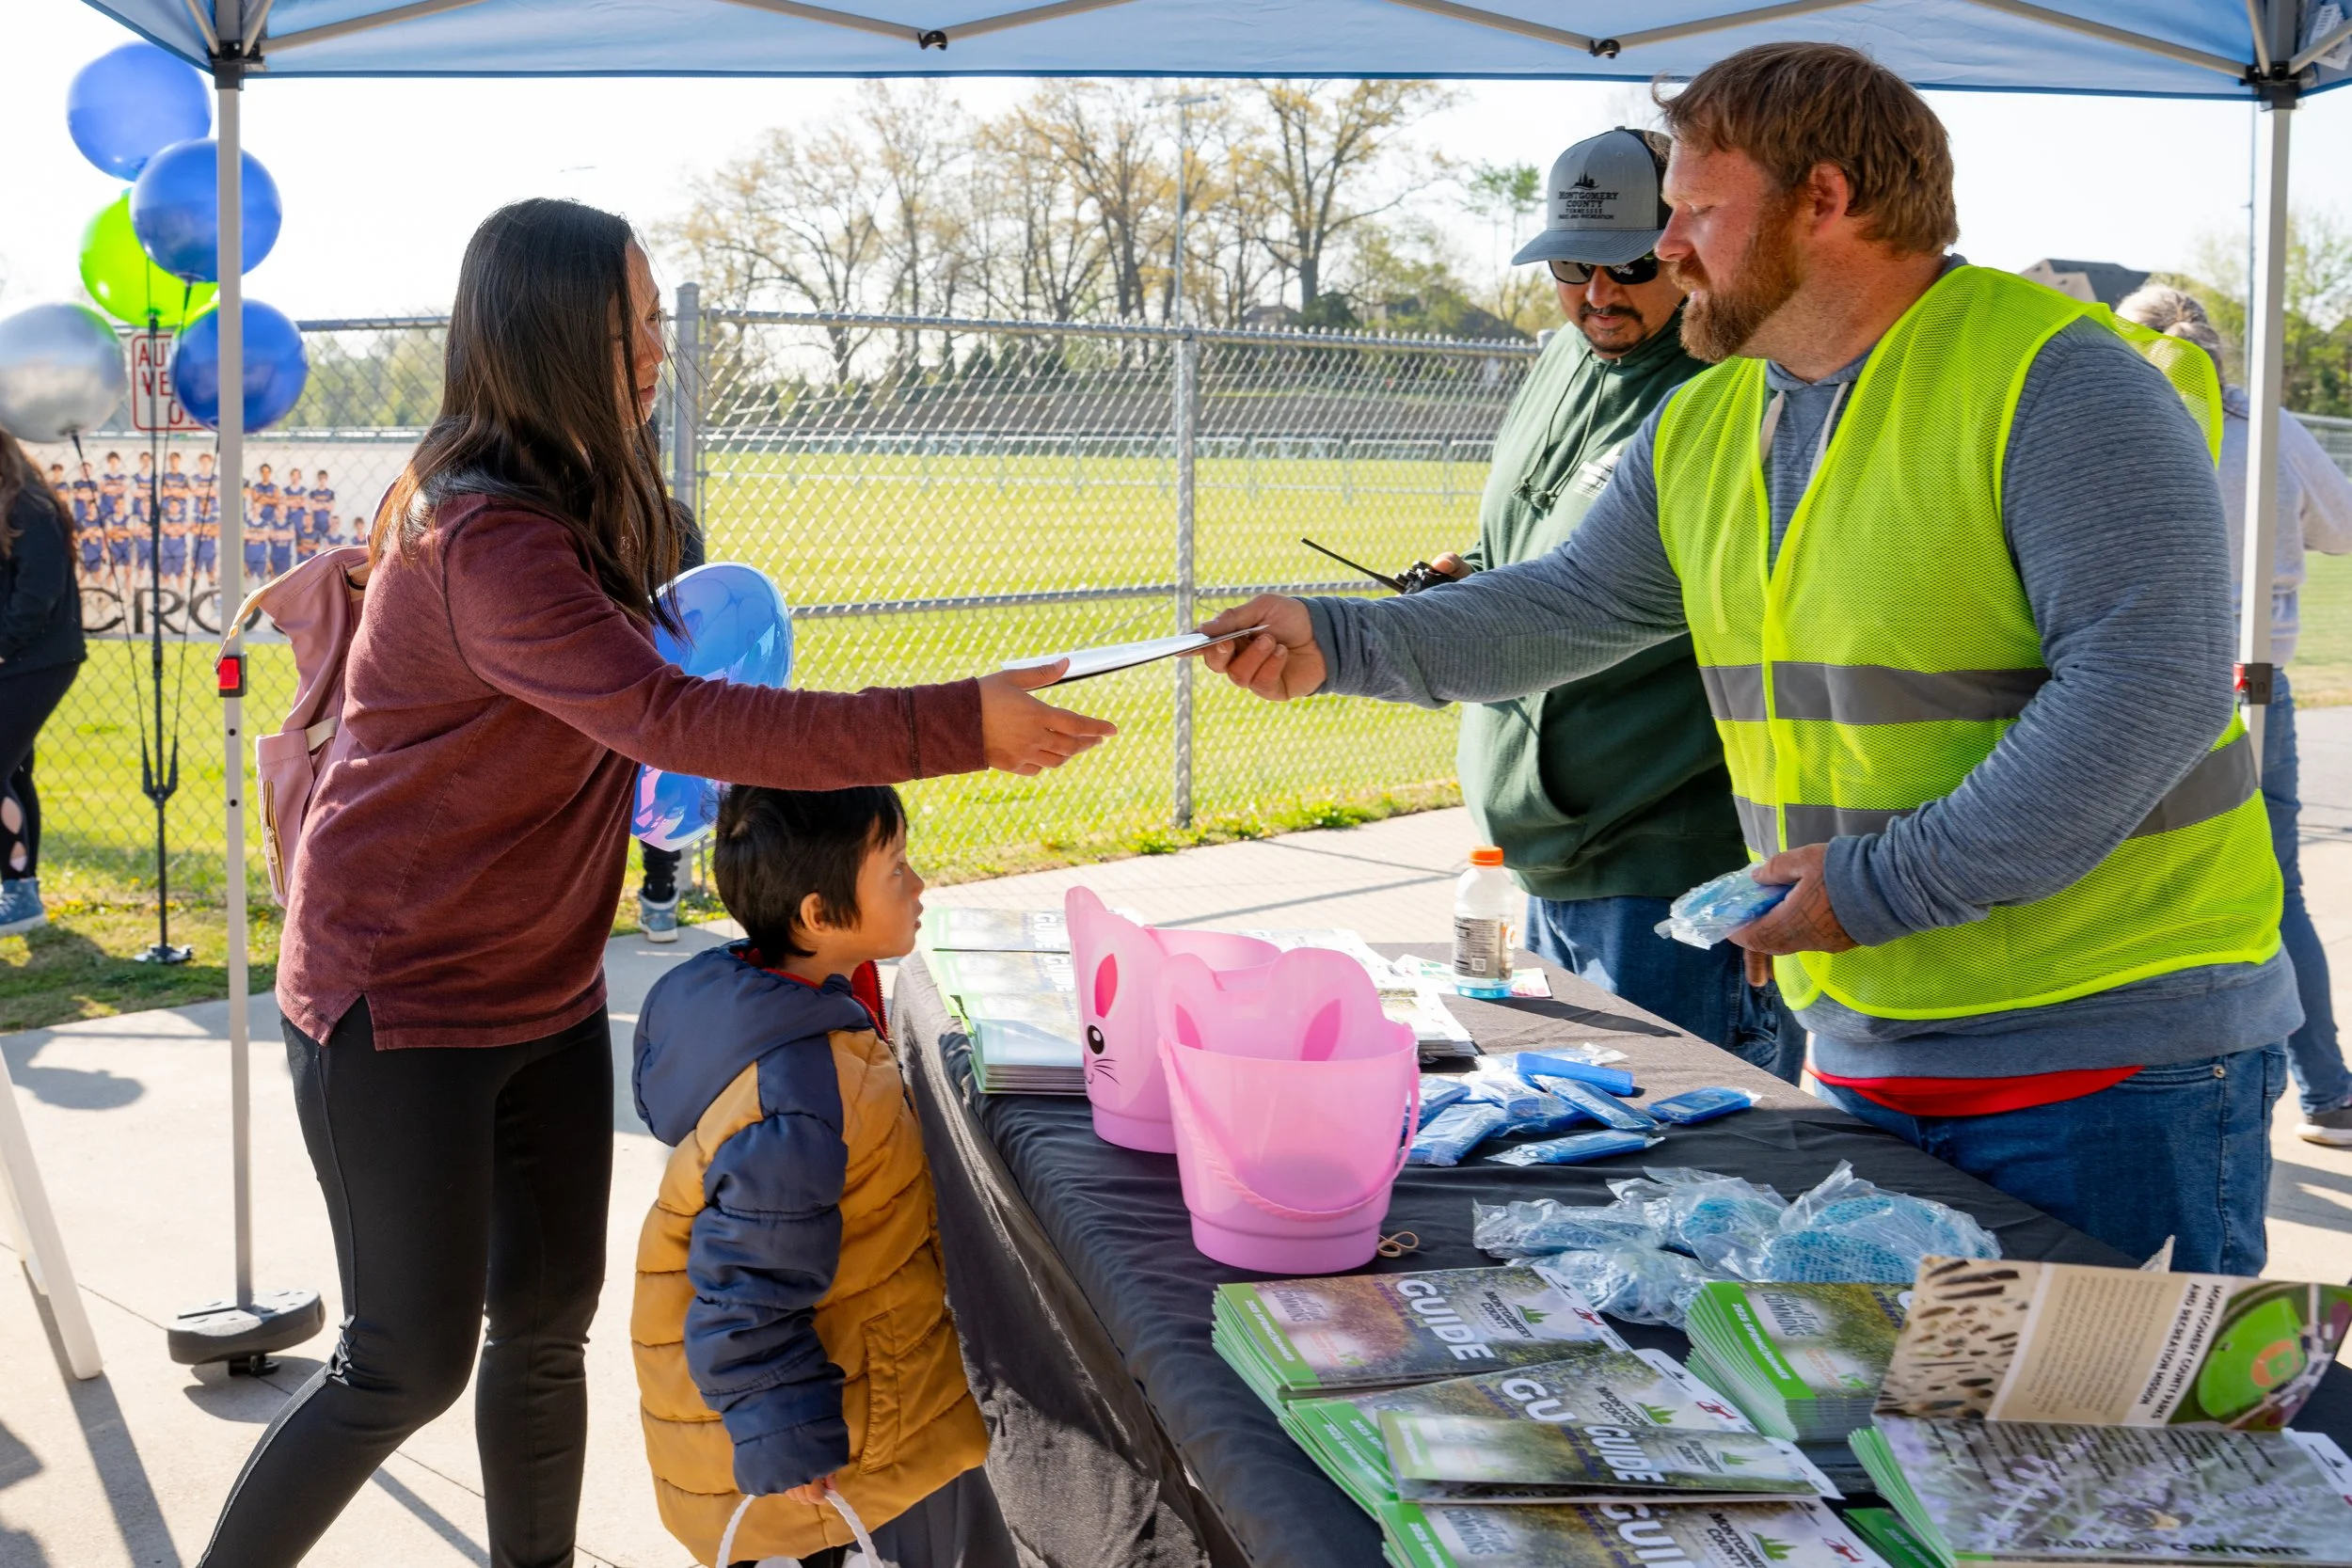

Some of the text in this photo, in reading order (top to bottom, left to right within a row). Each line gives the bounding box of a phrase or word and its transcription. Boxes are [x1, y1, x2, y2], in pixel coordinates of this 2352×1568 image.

[1558, 191, 1619, 200] MONTGOMERY
[1566, 199, 1604, 208] COUNTY
[1396, 1279, 1496, 1361] GUIDE
[1480, 1302, 1513, 1329] COUNTY
[1483, 1291, 1535, 1338] MONTGOMERY
[1760, 1292, 1806, 1337] COMMONS
[2139, 1284, 2201, 1404] AND RECREATION MISSION
[2151, 1285, 2223, 1418] MONTGOMERY COUNTY PARKS
[1596, 1386, 1649, 1426] MONTGO
[1583, 1425, 1666, 1482] GUIDE
[2040, 1539, 2312, 1556] TABLE OF CONTENTS
